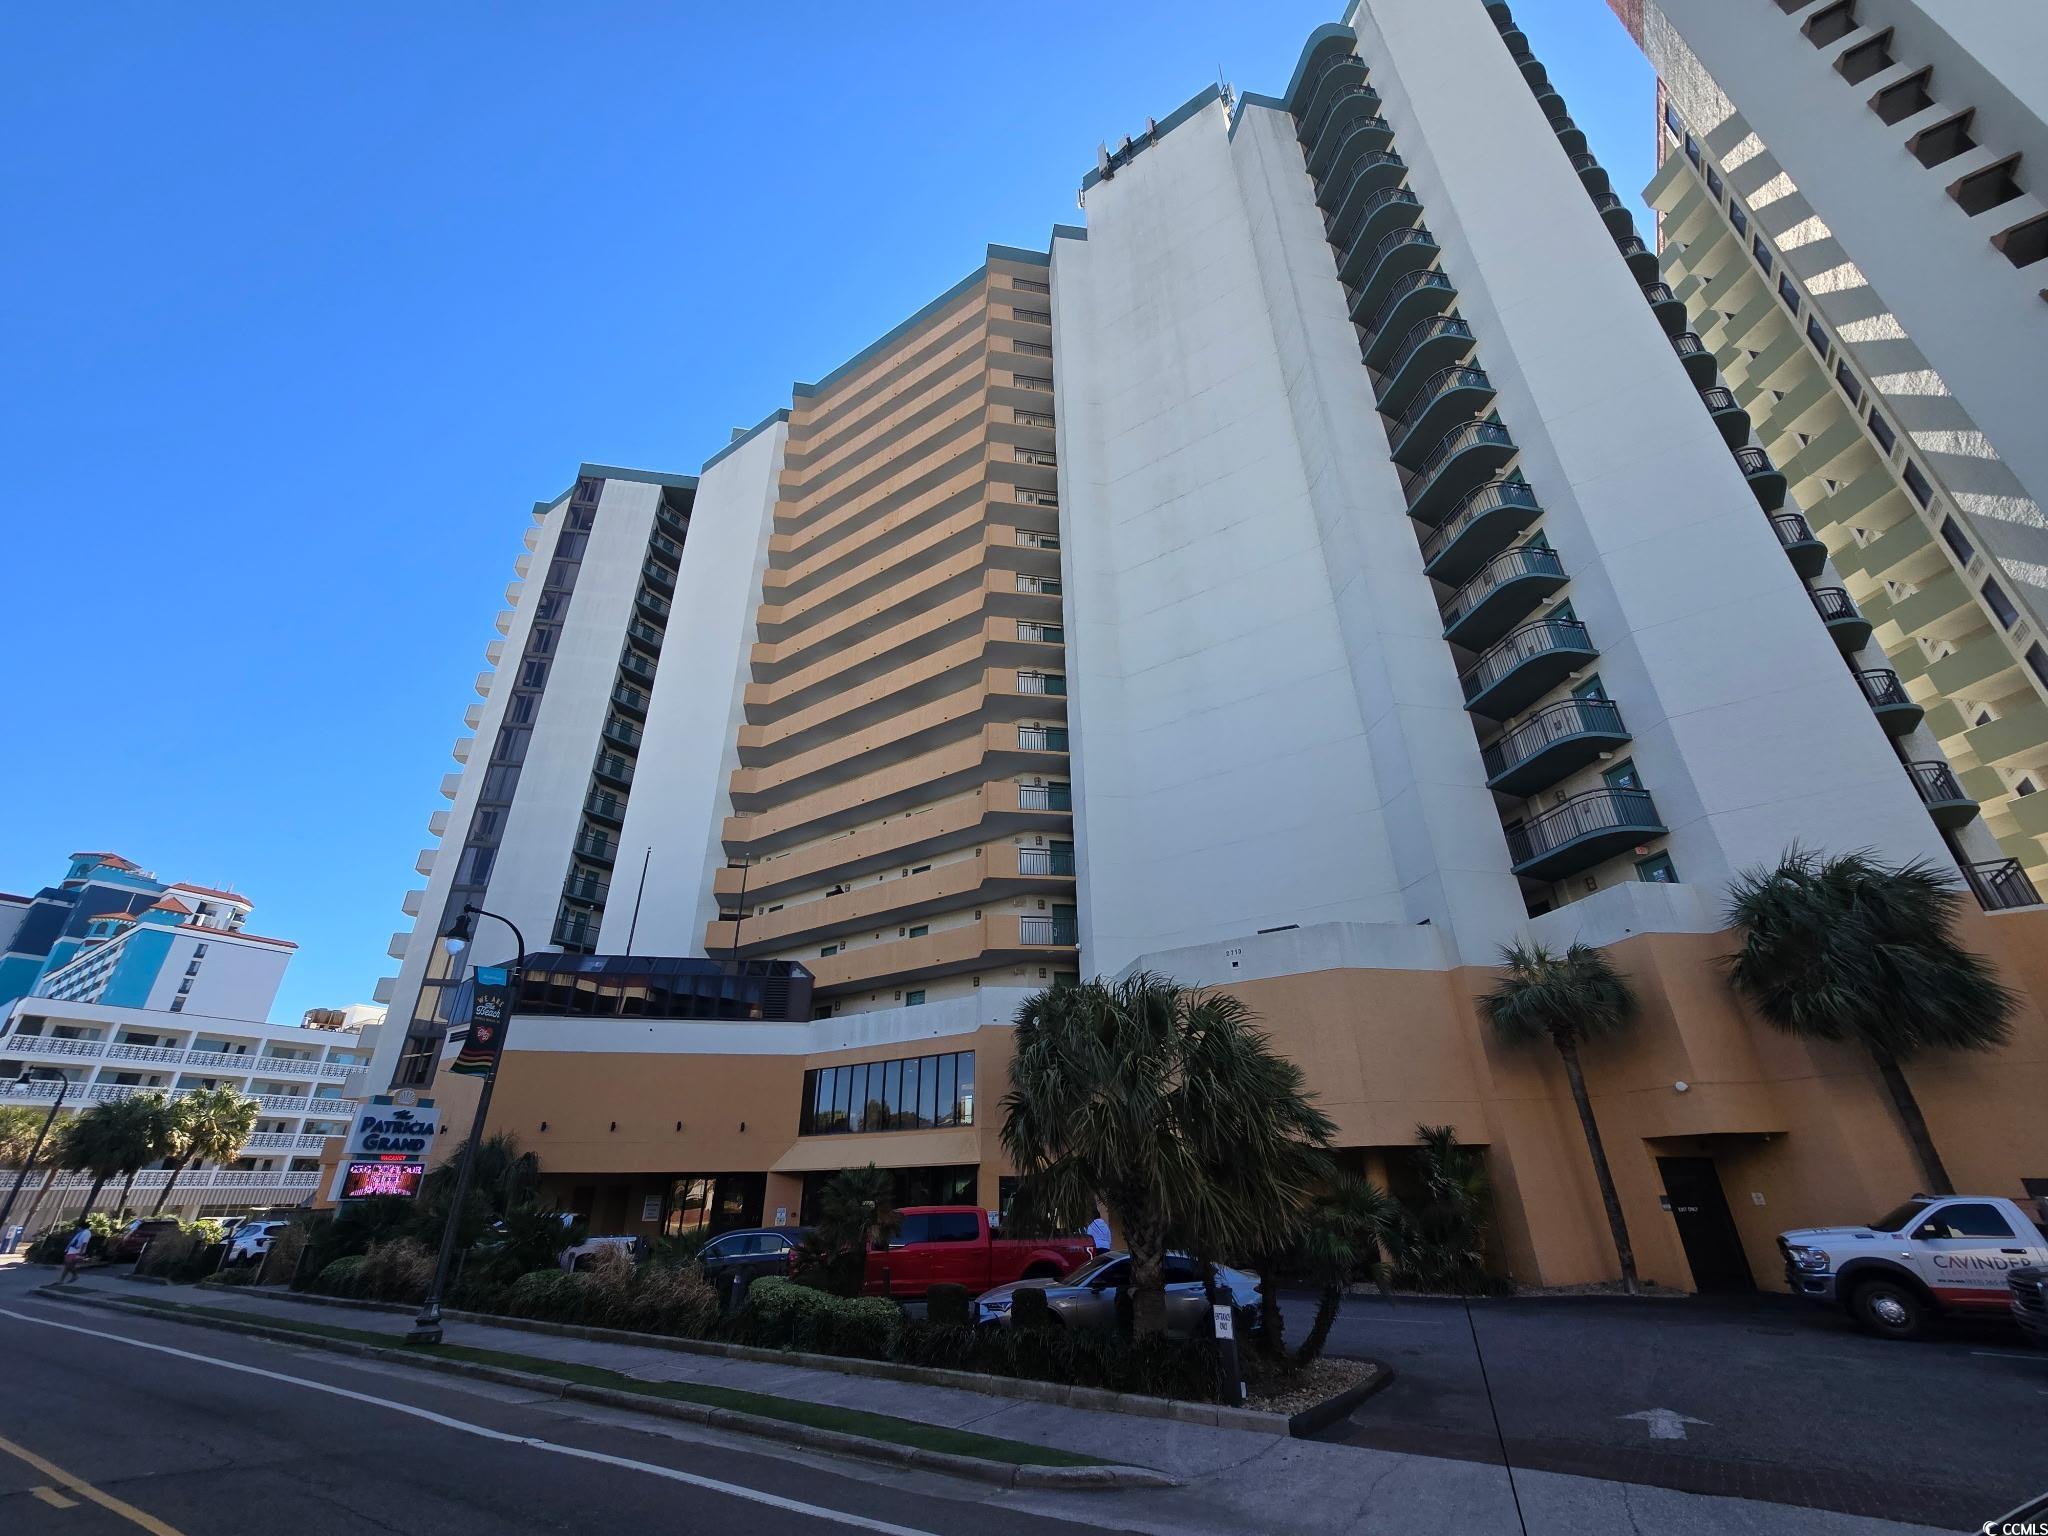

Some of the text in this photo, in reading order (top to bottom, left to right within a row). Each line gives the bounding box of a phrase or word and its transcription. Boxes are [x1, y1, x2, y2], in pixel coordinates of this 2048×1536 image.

[475, 1005, 501, 1018] Beach
[360, 1116, 435, 1136] PATRICIA
[362, 1133, 426, 1152] GRAND
